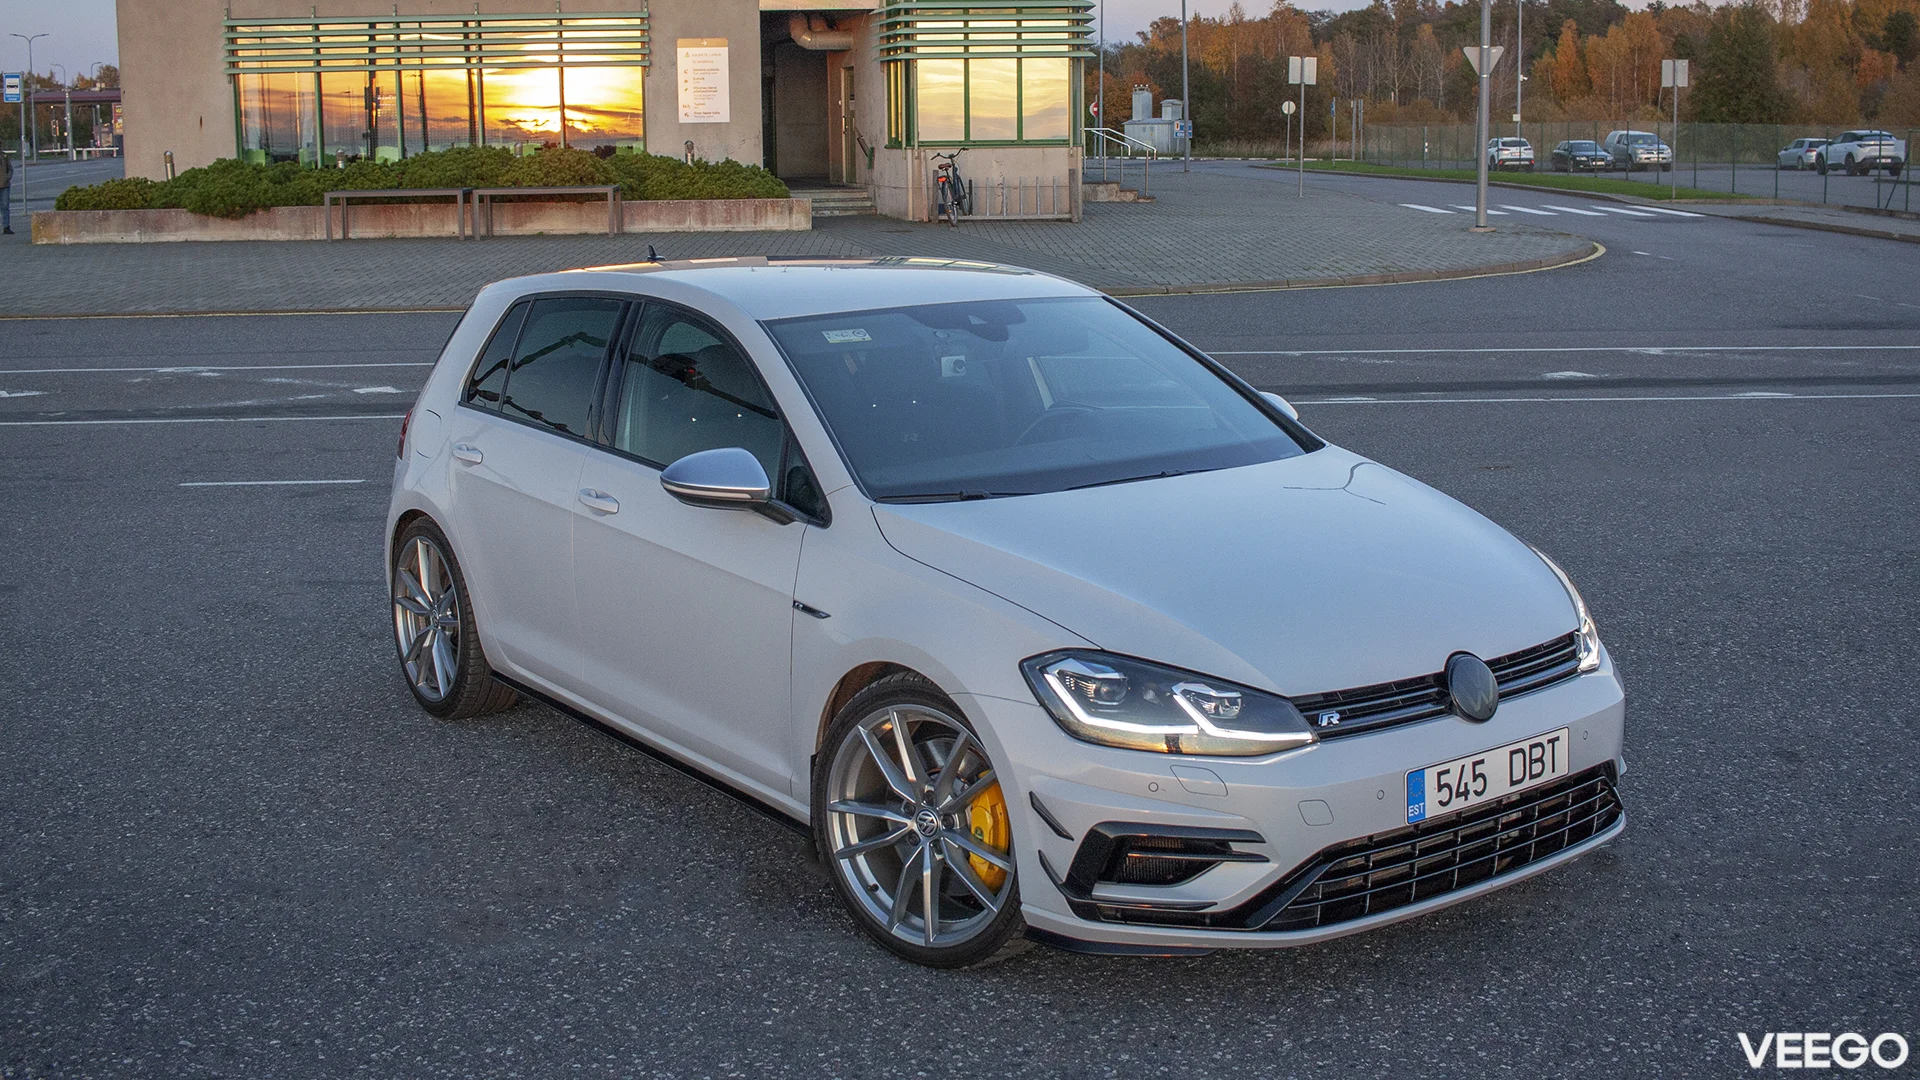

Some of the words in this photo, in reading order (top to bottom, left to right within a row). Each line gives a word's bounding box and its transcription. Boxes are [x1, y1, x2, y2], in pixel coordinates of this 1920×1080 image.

[1318, 711, 1341, 727] R
[1436, 758, 1487, 807] 545
[1508, 735, 1560, 787] DBT
[1408, 802, 1425, 817] EST
